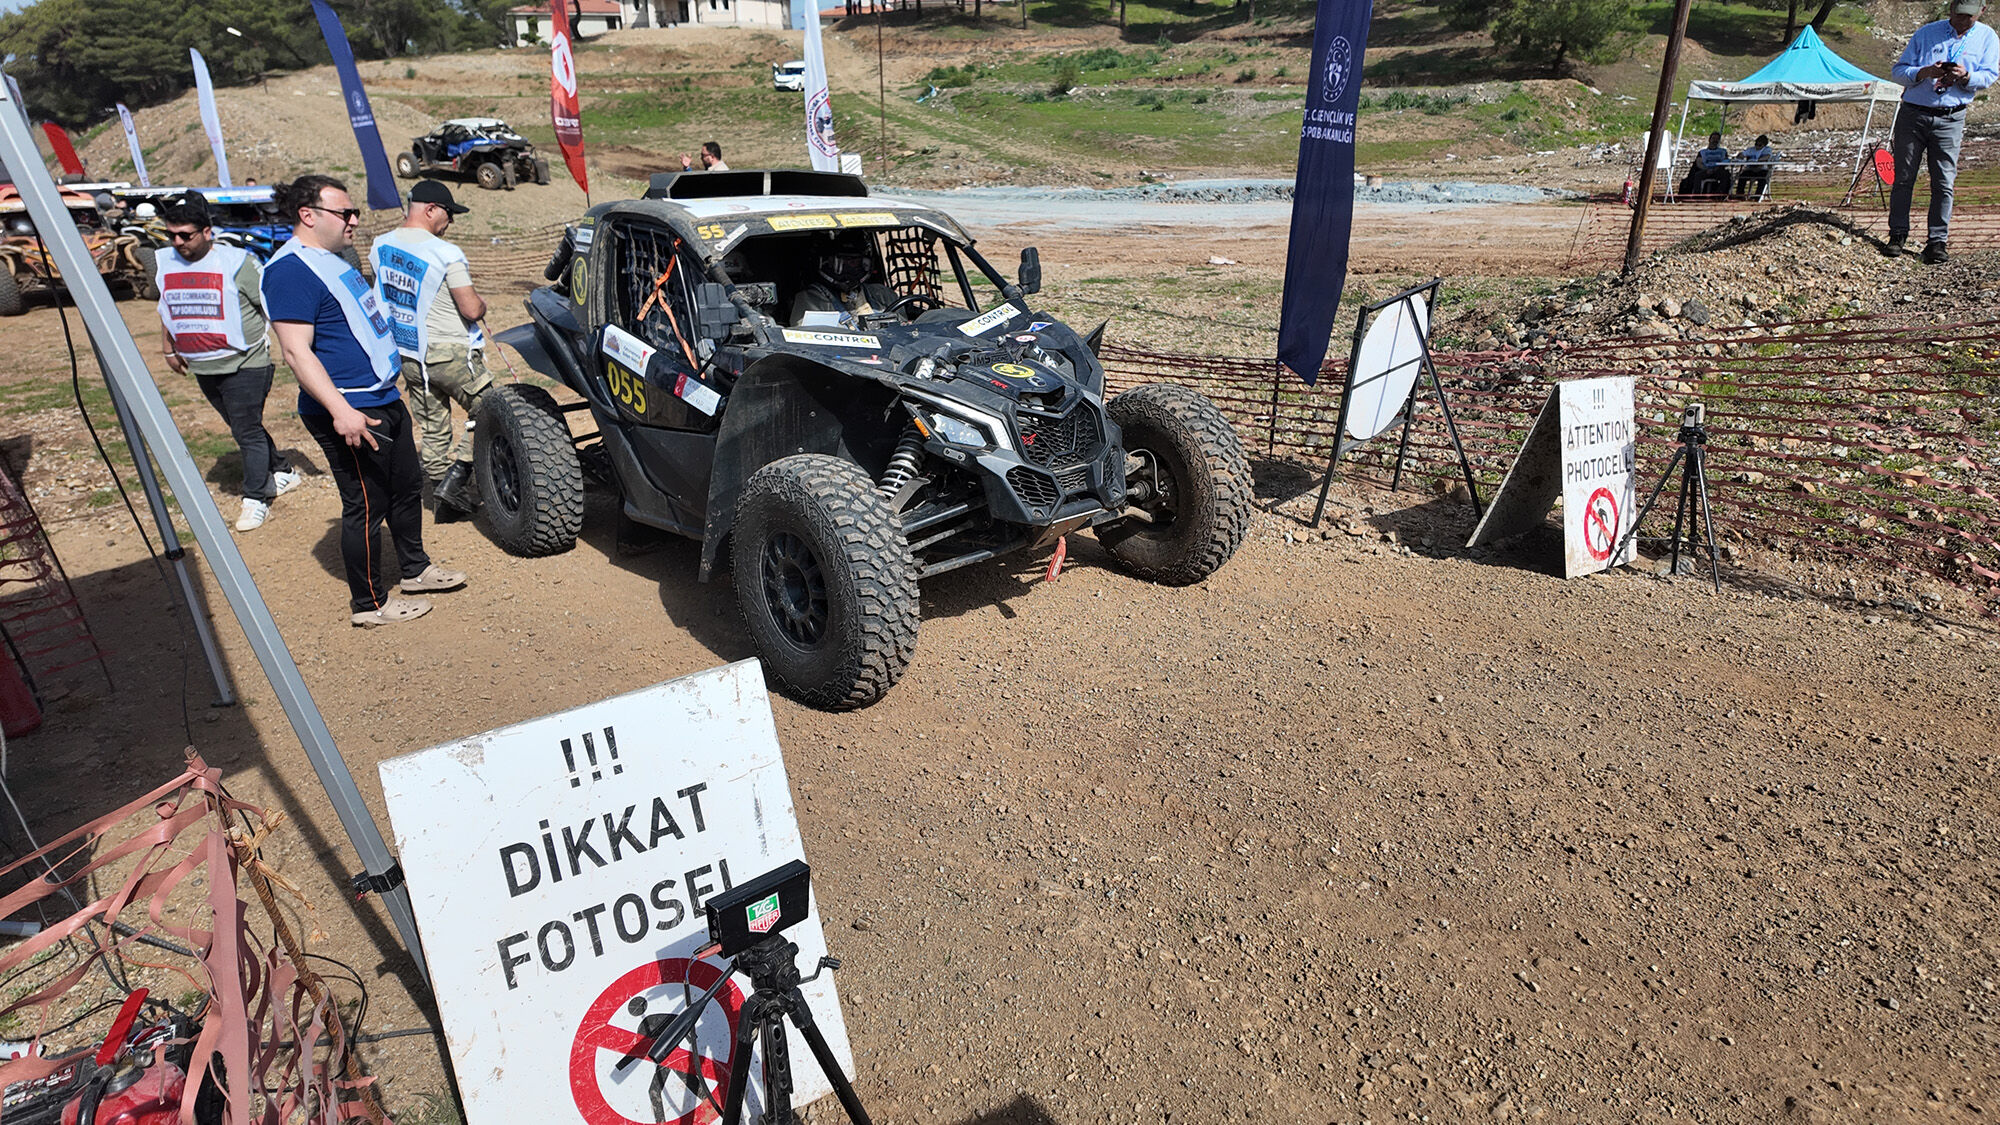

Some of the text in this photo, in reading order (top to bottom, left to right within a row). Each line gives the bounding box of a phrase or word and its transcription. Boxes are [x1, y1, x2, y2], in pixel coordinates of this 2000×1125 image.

[1344, 112, 1354, 126] VE
[697, 224, 725, 239] 55
[784, 332, 877, 345] PROCONTROL
[607, 360, 646, 414] 055
[1566, 419, 1630, 450] ATTENTION
[1566, 452, 1632, 485] PHOTOCELL
[560, 725, 623, 789] !!!
[498, 781, 708, 898] DİKKAT
[750, 910, 779, 931] HEUER
[752, 899, 775, 918] TAG
